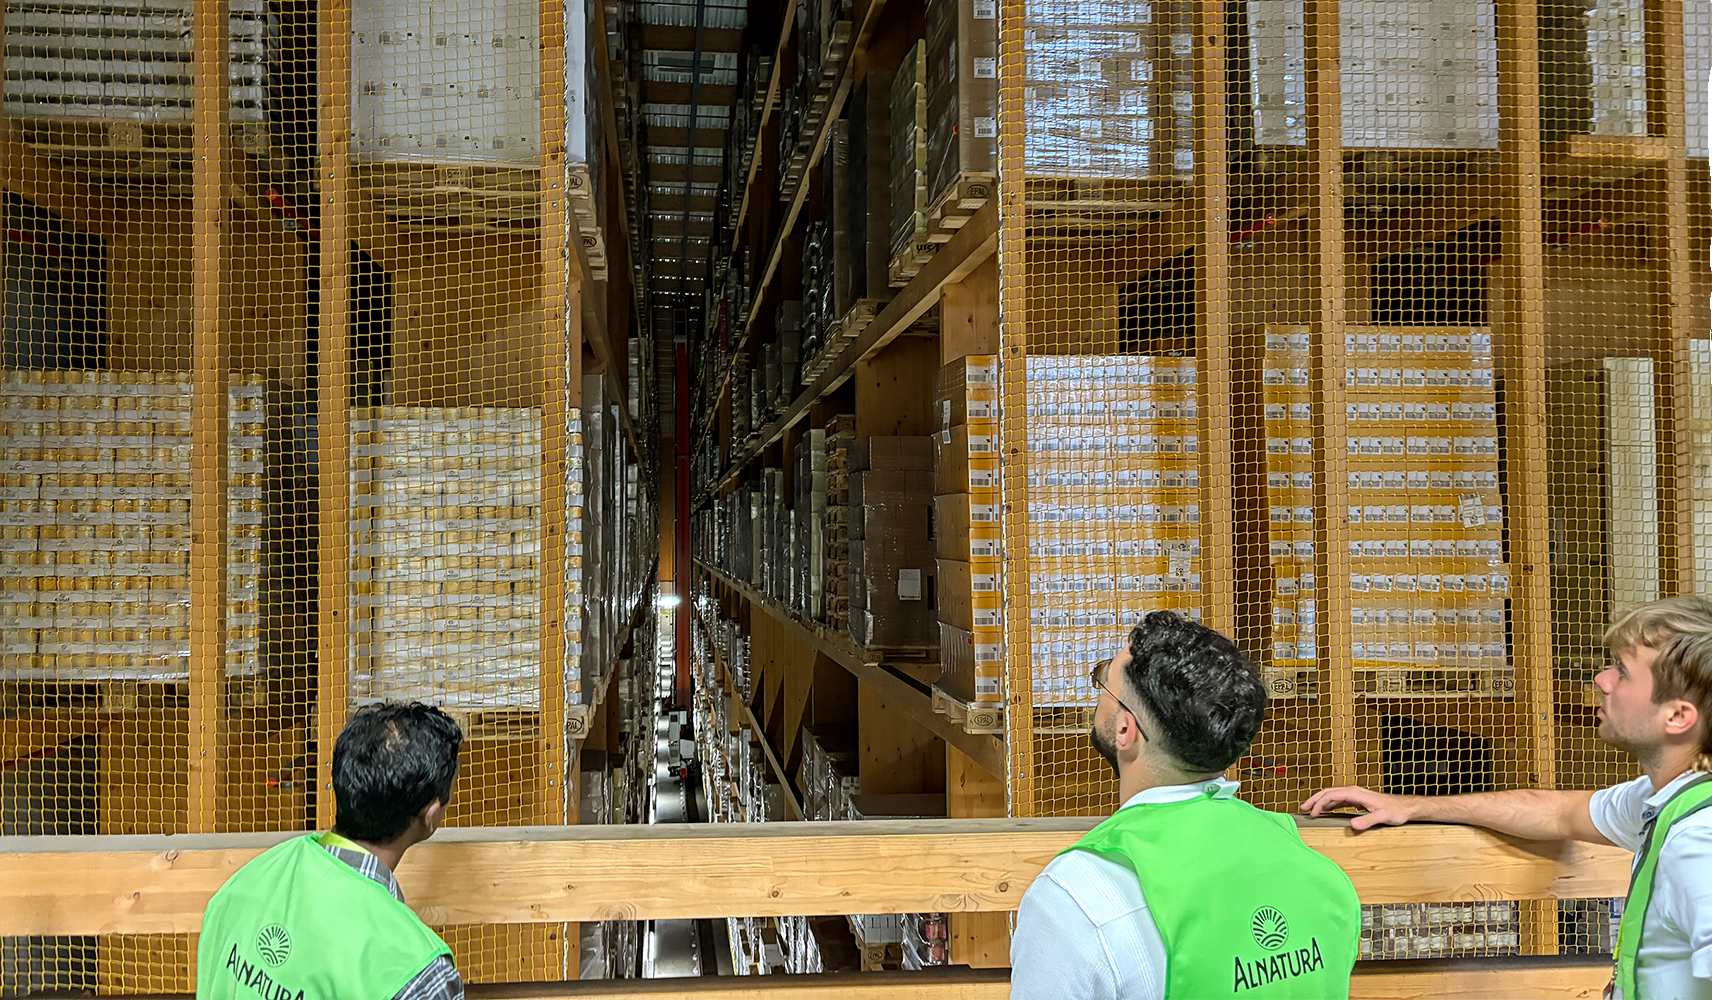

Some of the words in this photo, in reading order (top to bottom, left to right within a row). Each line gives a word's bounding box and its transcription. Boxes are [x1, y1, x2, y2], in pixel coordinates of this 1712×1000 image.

[969, 187, 985, 195] EPAL
[1274, 682, 1290, 690] EPAL
[976, 716, 989, 724] EPAL
[567, 721, 578, 730] PAL
[1234, 937, 1324, 993] ALNATURA
